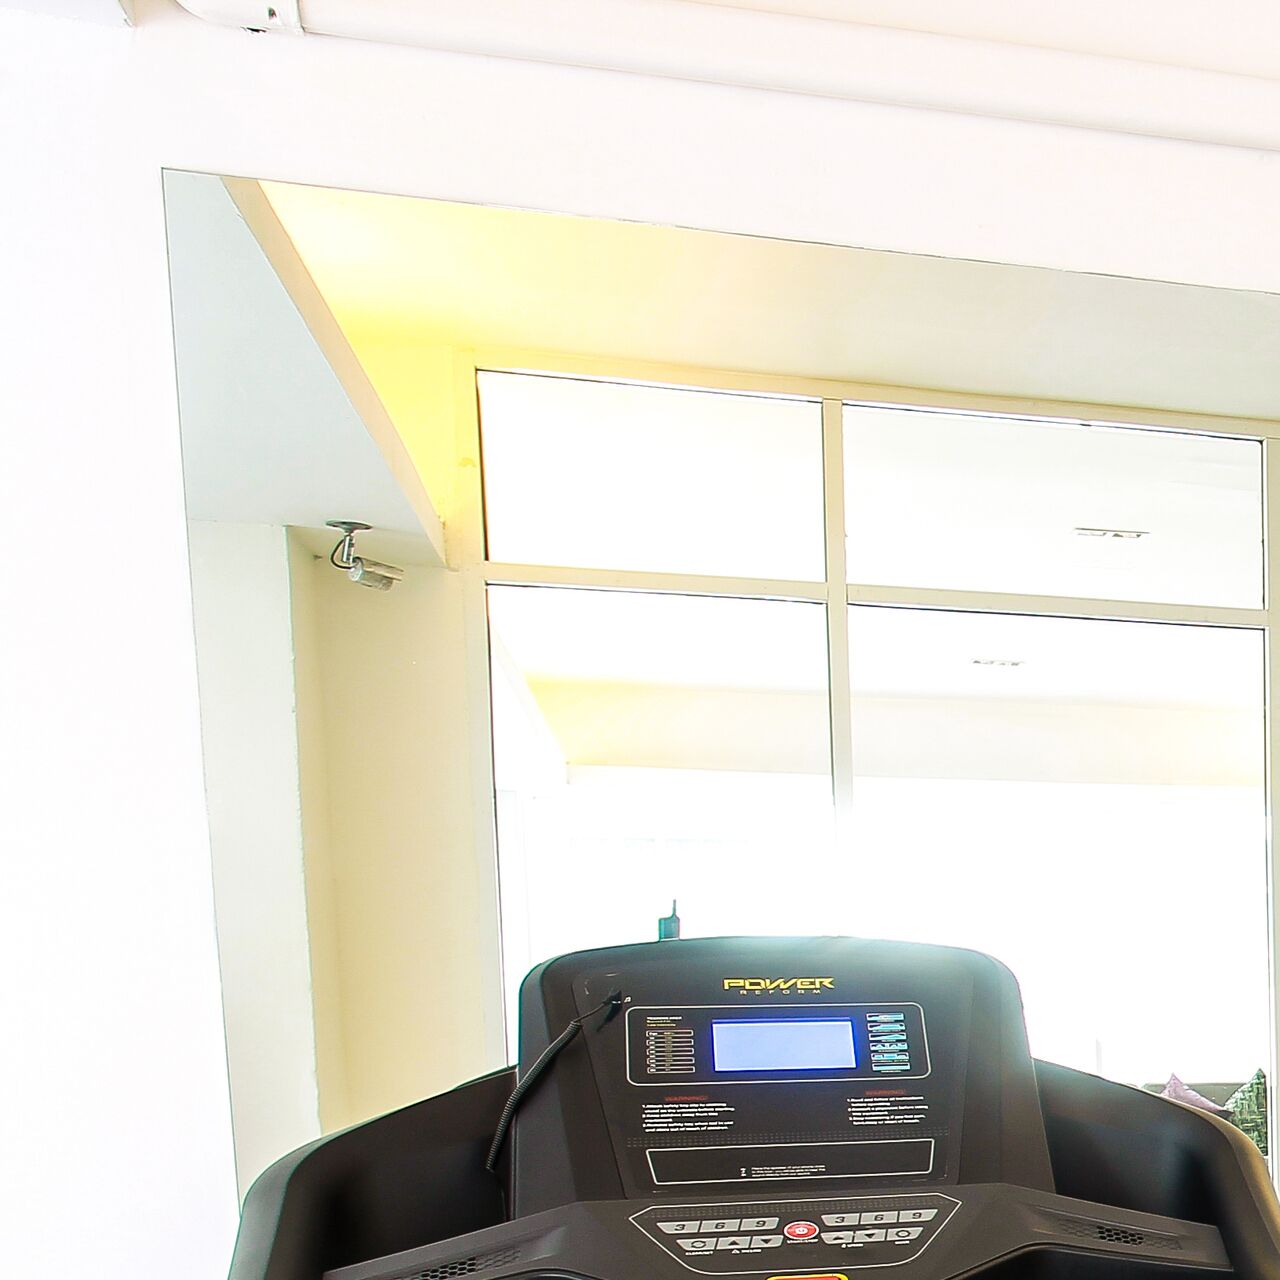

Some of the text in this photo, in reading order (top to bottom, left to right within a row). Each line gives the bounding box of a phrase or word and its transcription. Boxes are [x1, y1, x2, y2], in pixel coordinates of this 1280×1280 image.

[723, 977, 835, 990] POWER
[834, 1212, 923, 1224] 3 6 9
[674, 1220, 767, 1232] 3 6 9
